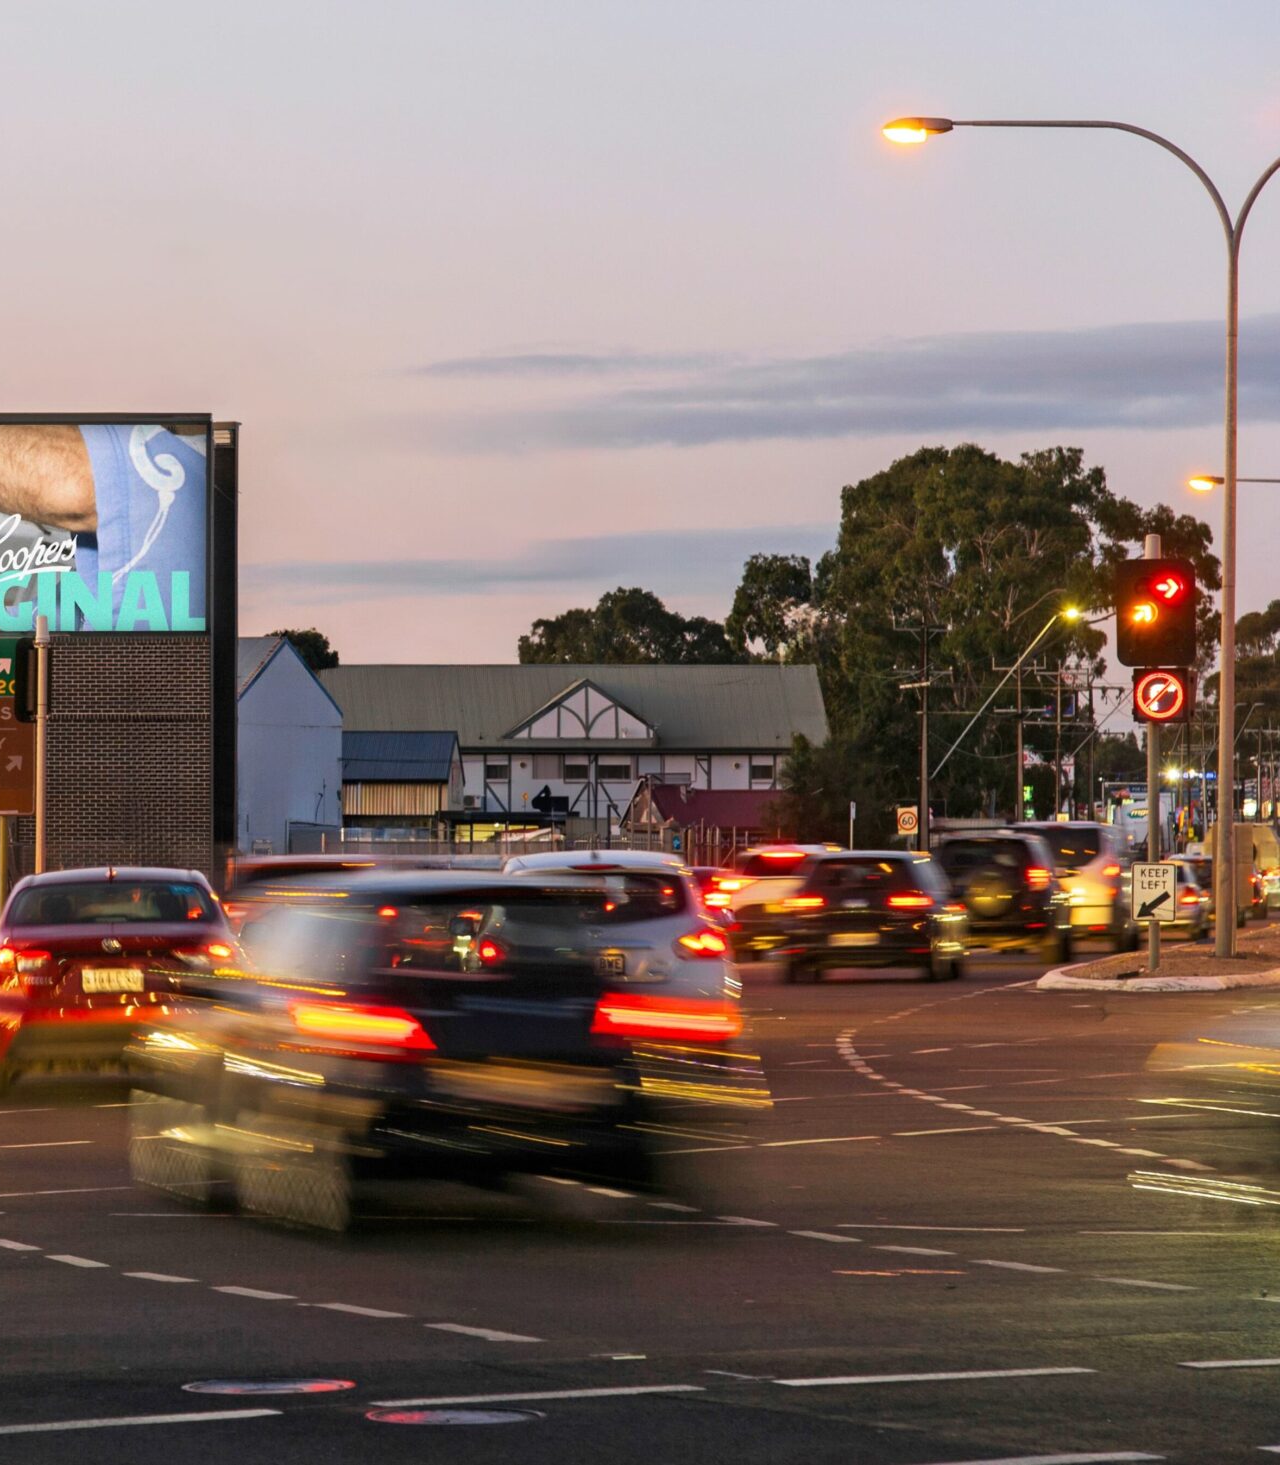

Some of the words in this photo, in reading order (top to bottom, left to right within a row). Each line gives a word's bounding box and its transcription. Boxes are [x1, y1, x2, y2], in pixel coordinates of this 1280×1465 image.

[902, 816, 914, 826] 60
[1140, 868, 1169, 878] KEEP
[1141, 881, 1167, 890] LEFT
